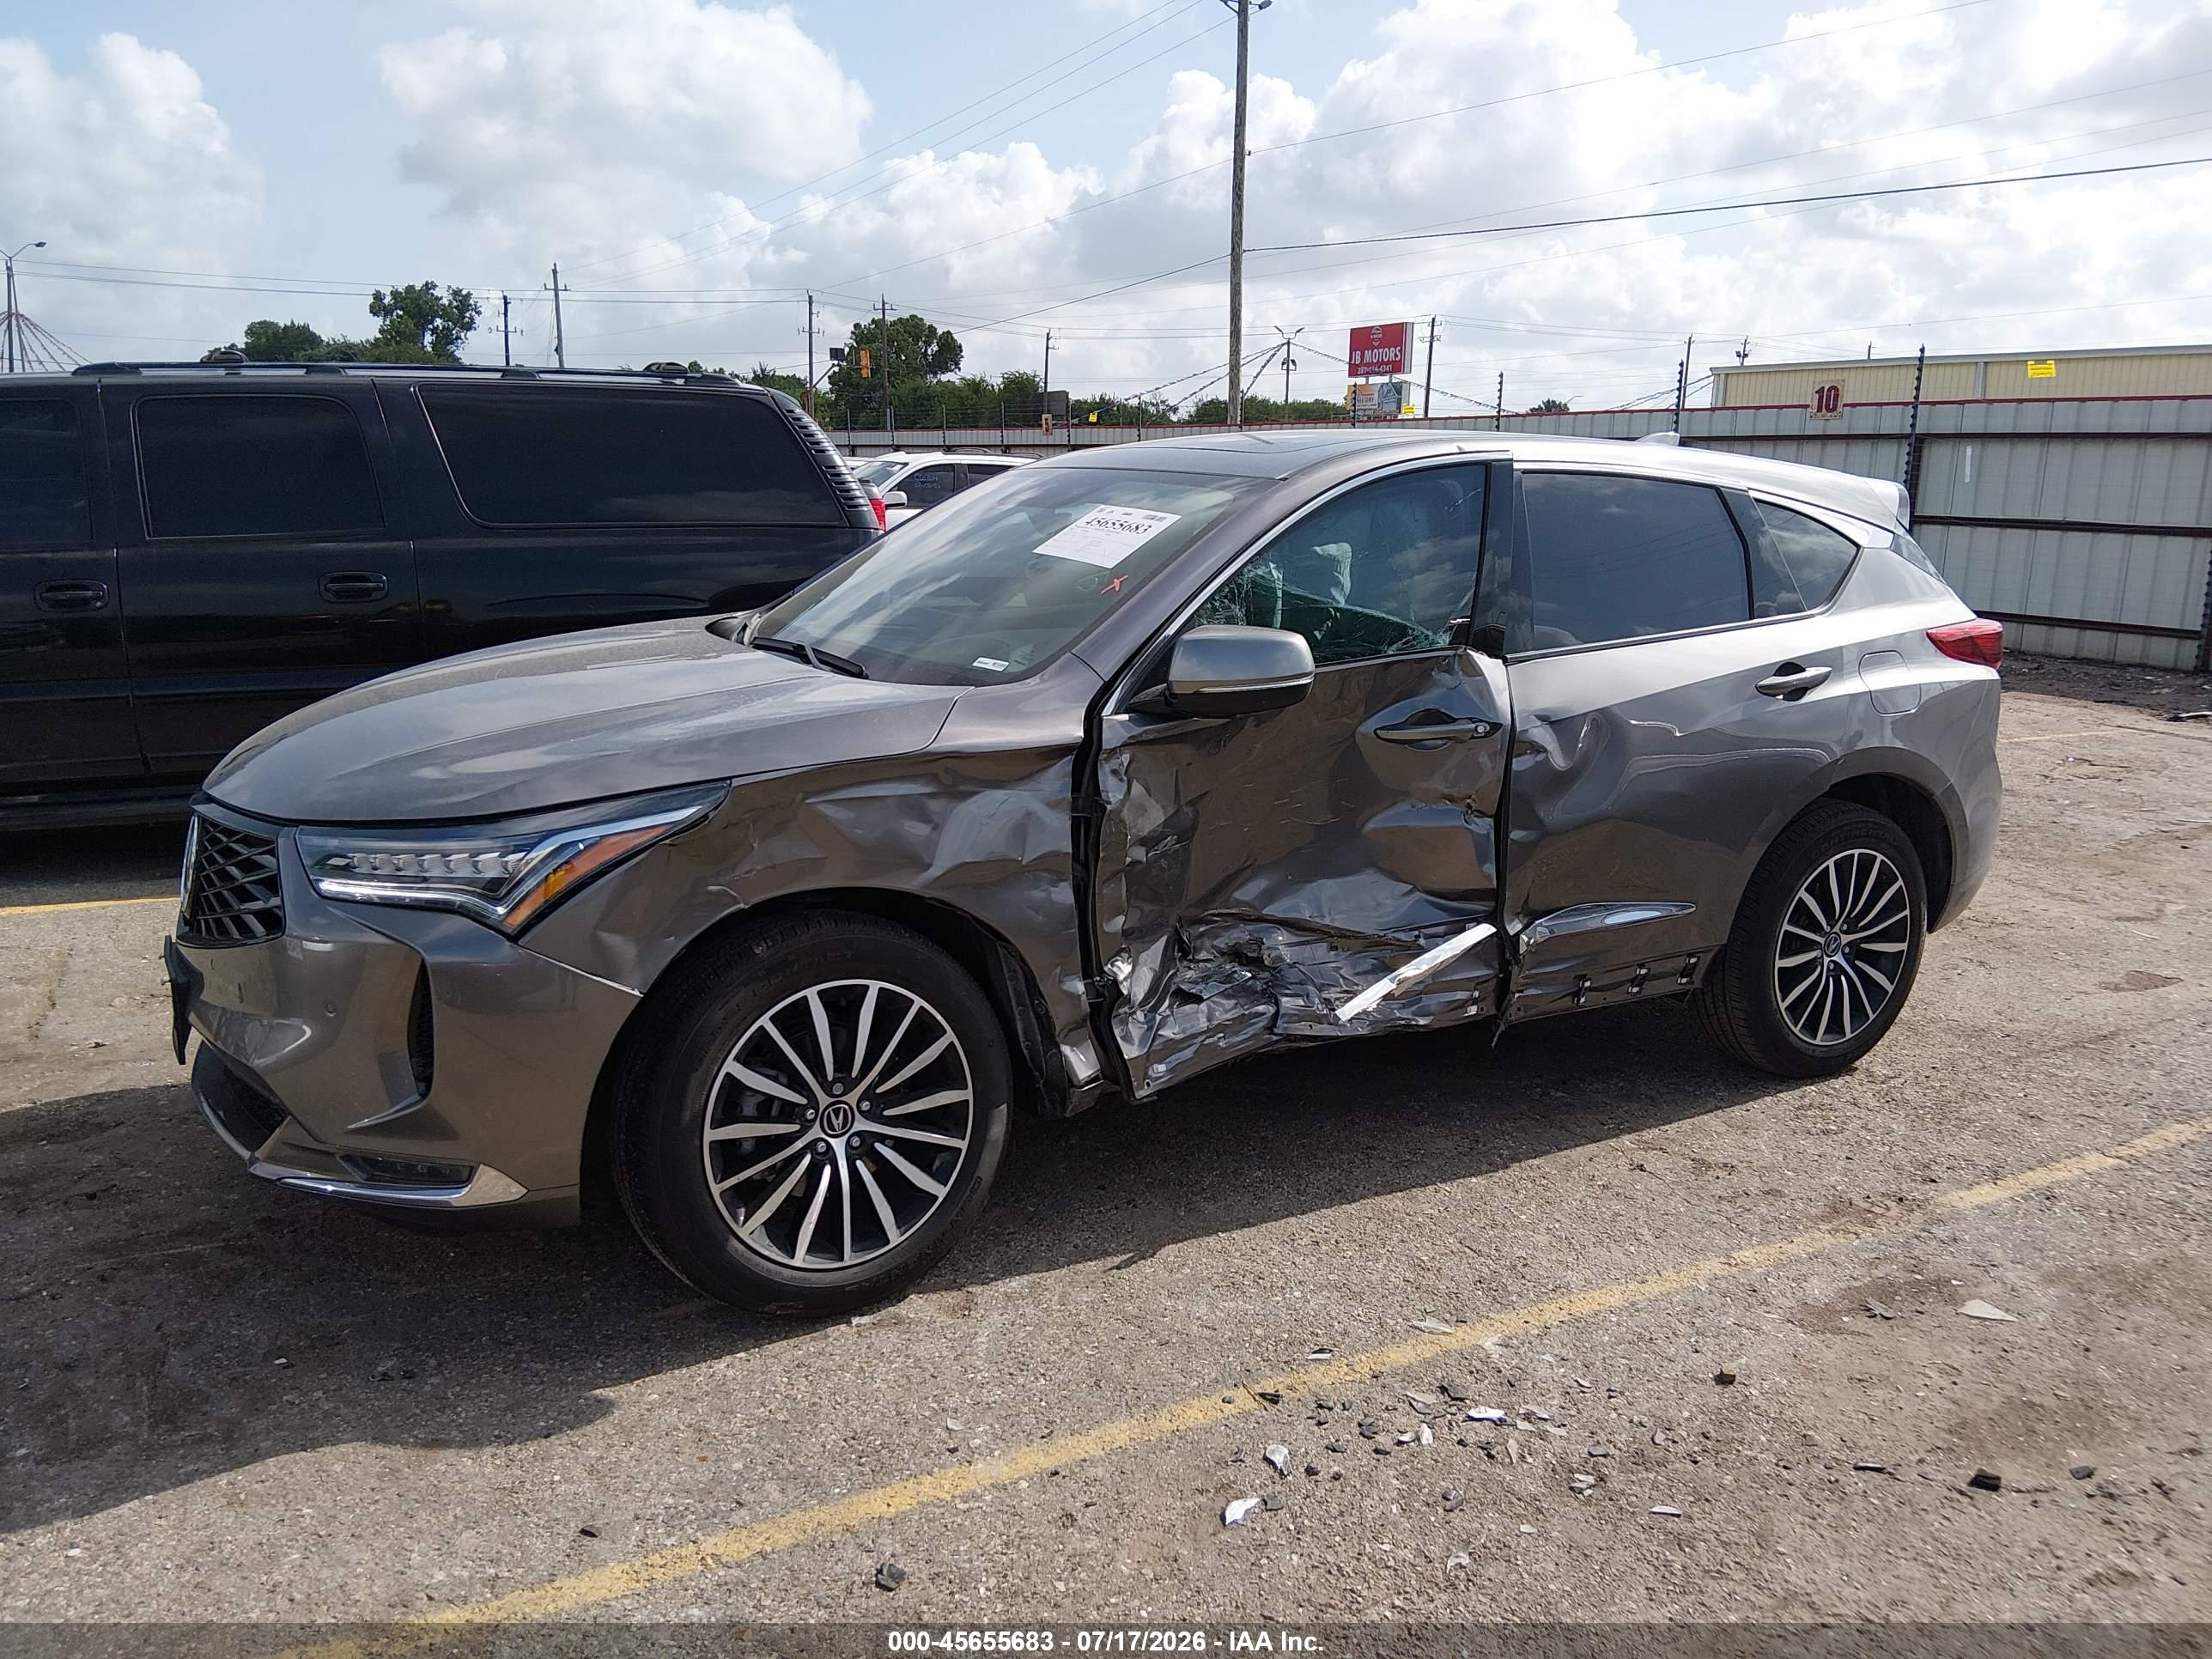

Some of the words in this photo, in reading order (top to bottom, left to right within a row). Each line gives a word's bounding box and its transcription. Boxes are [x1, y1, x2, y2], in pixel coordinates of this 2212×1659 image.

[1352, 350, 1361, 364] JB
[1364, 347, 1401, 363] MOTORS
[1814, 385, 1839, 413] 10
[1085, 516, 1152, 534] 45655683
